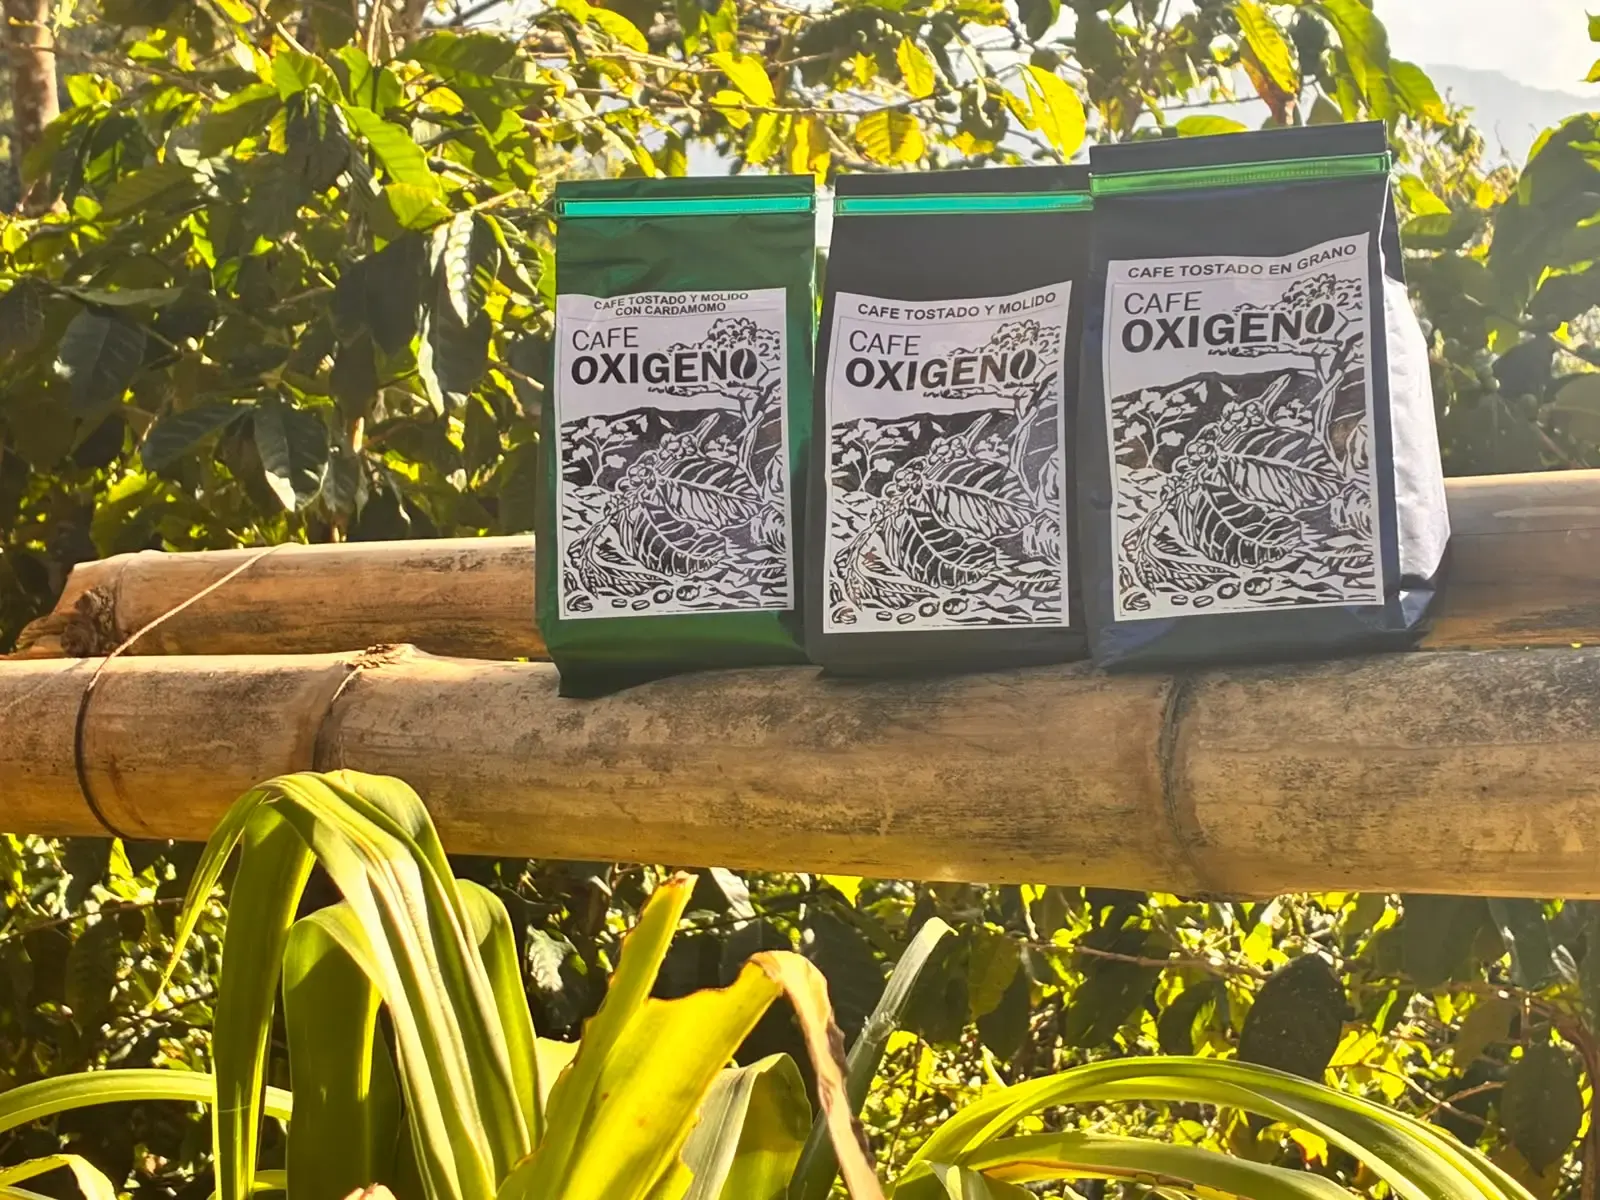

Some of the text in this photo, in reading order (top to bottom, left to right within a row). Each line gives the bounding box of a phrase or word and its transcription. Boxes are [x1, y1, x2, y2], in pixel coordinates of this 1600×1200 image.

[1127, 243, 1357, 279] CAFE TOSTADO EN GRANO
[594, 292, 749, 310] CAFE TOSTADO Y MOLIDO
[615, 303, 726, 317] CON CARDAMOMO
[858, 292, 1056, 320] CAFE TOSTADO Y MOLIDO
[1124, 290, 1202, 315] CAFE
[572, 326, 639, 351] CAFE
[849, 330, 921, 356] CAFE
